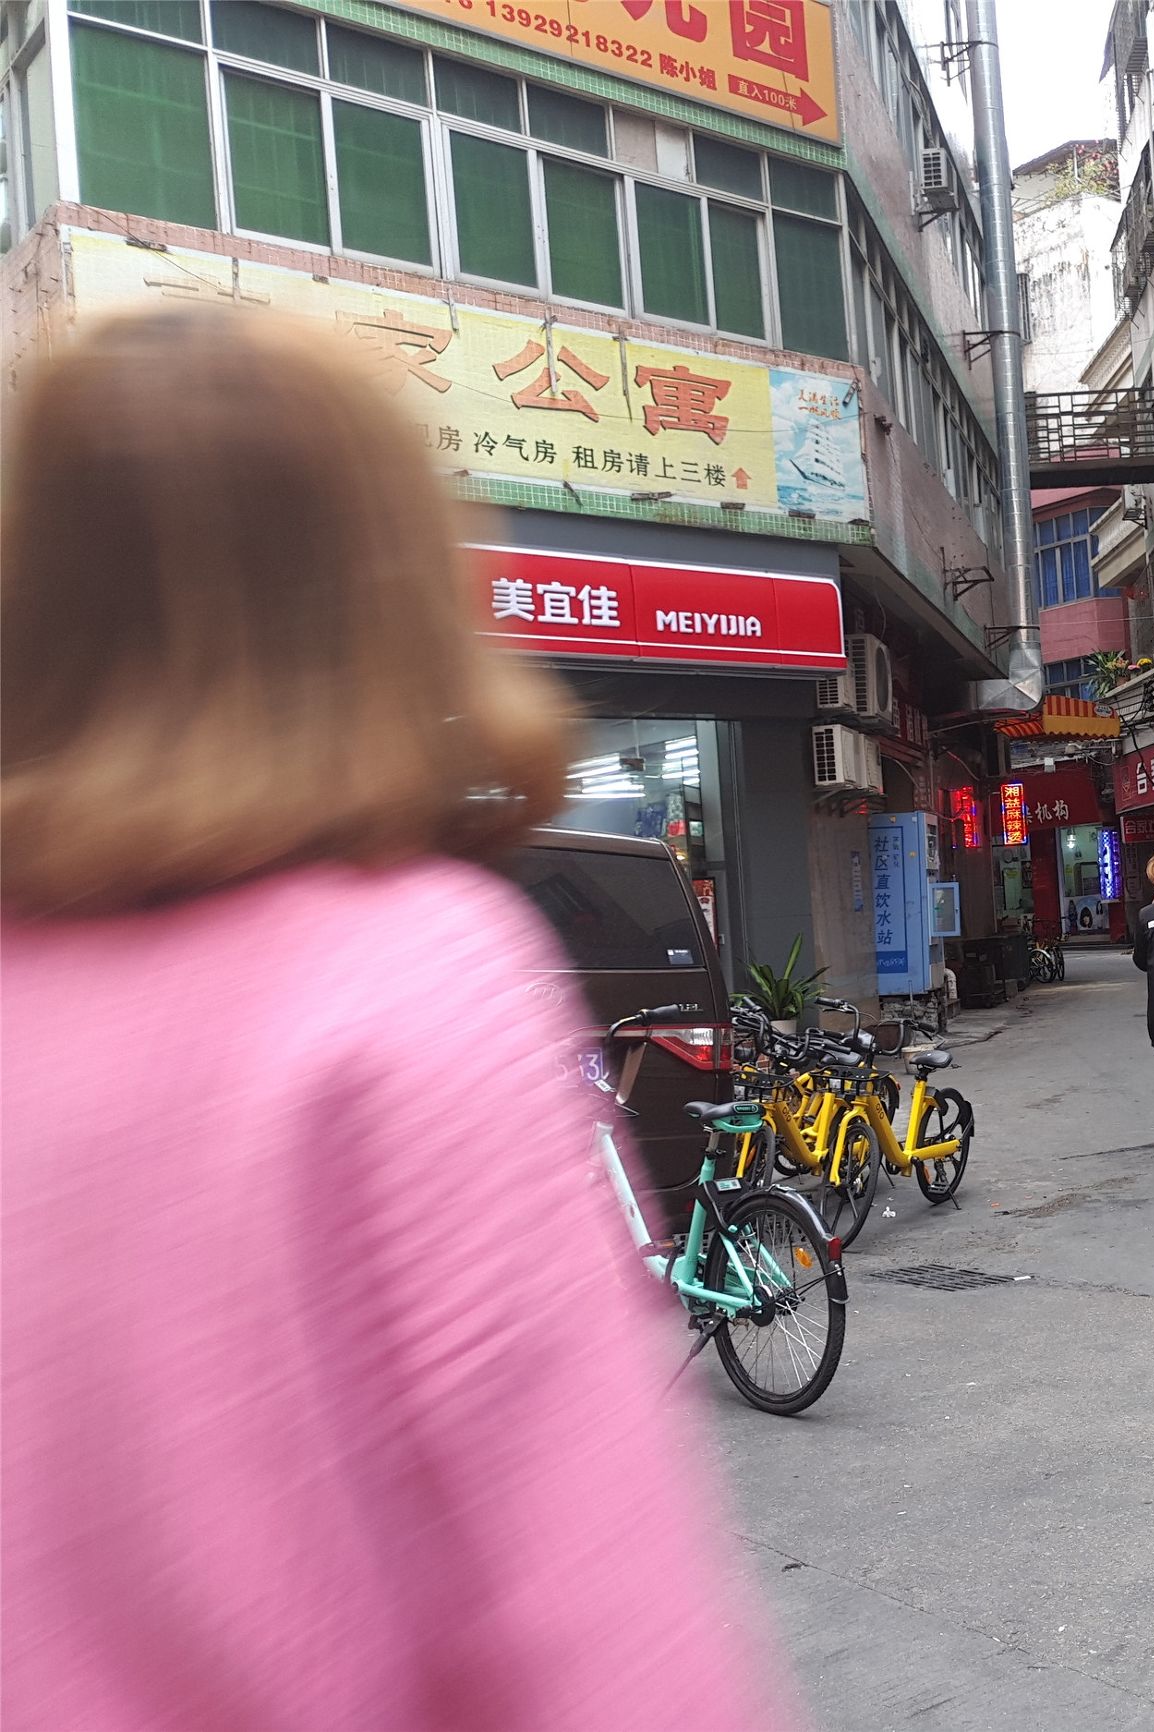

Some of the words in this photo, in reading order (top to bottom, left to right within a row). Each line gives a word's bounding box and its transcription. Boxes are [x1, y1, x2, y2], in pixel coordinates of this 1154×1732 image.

[486, 0, 653, 68] 13929218322
[659, 53, 718, 91] 陈小姐
[736, 80, 798, 111] 直入100米
[143, 275, 733, 446] 家公寓
[473, 431, 558, 465] 冷气房
[572, 445, 727, 488] 租房请上三楼
[491, 577, 621, 627] 美宜佳
[655, 609, 762, 637] MEIYIJIA
[874, 836, 893, 945] 社区直饮水站
